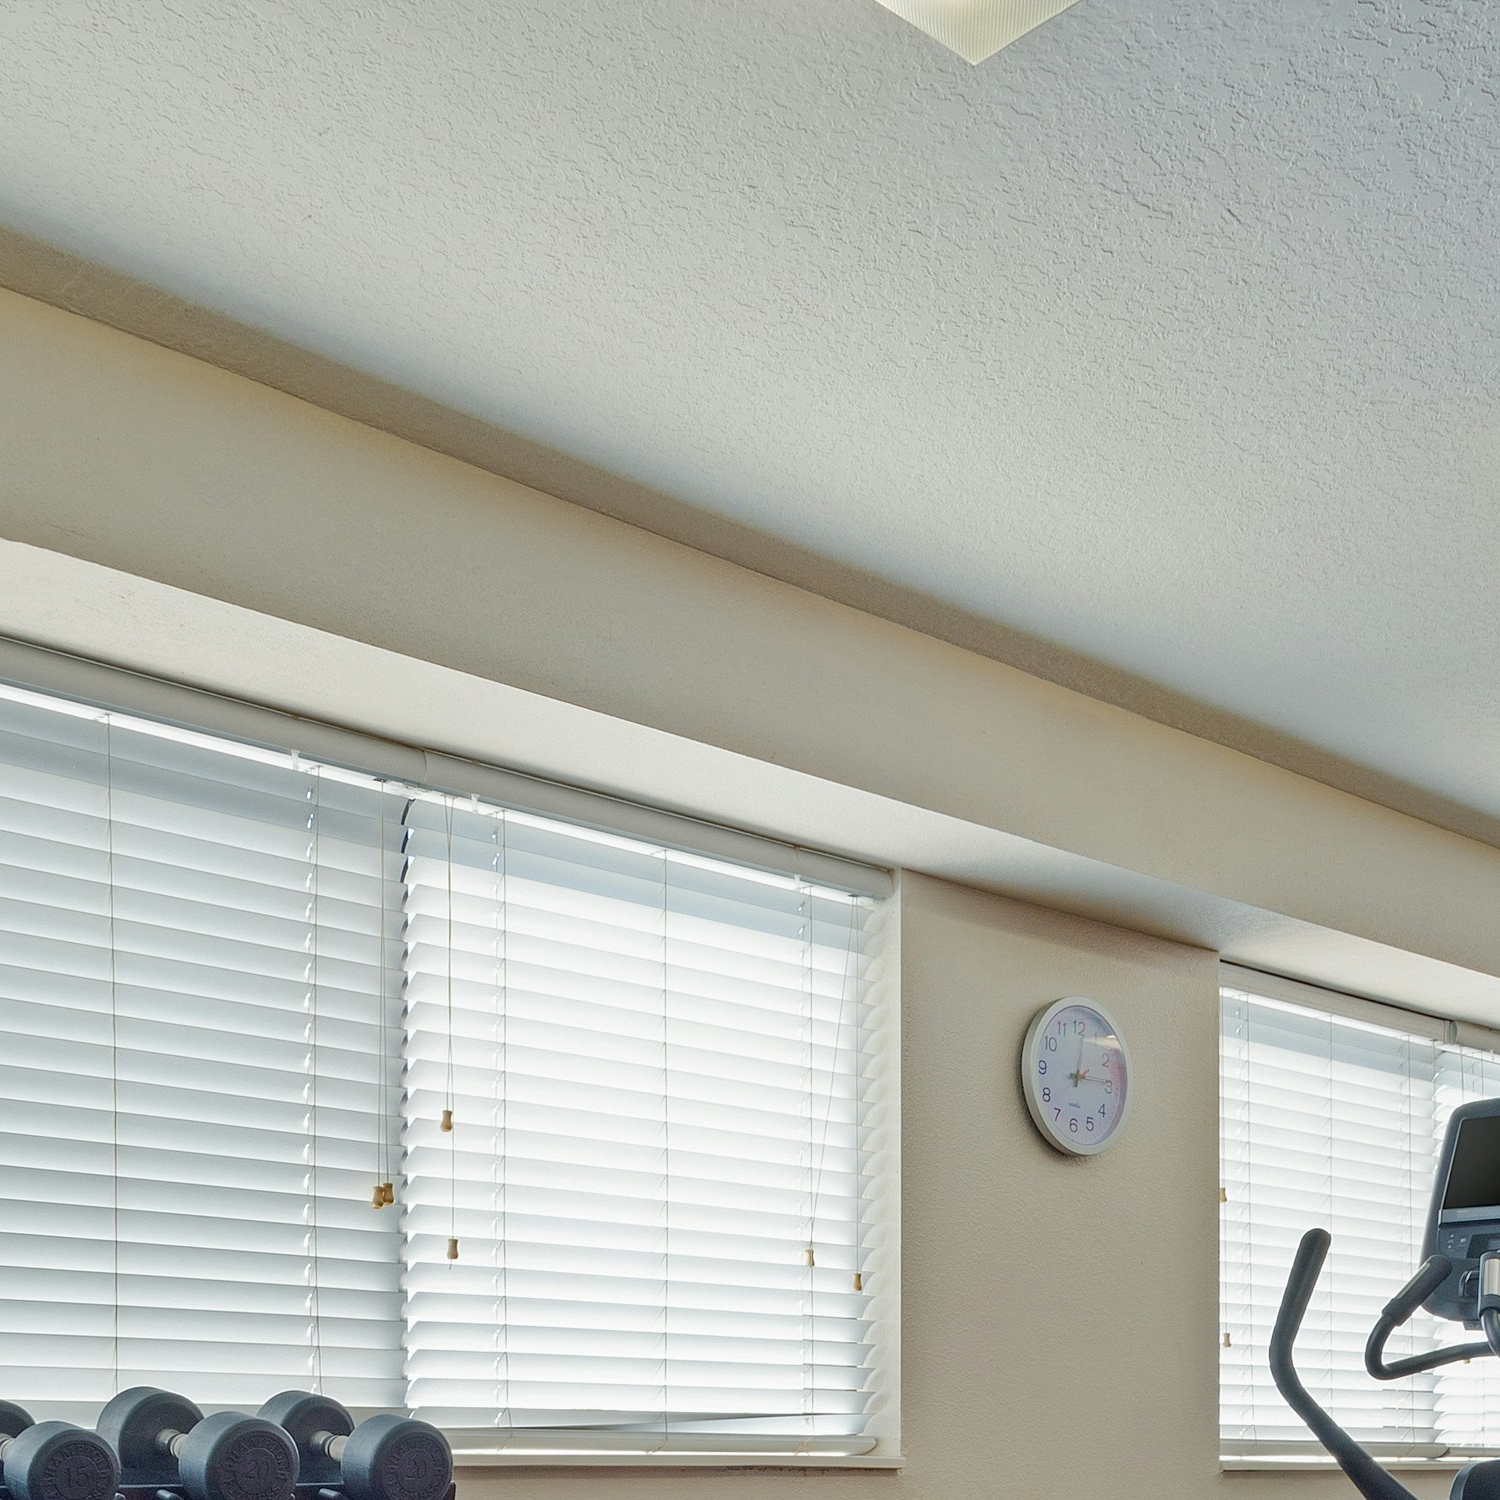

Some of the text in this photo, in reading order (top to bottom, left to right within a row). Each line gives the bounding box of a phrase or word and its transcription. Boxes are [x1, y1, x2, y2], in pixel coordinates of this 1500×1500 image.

[1058, 1021, 1066, 1037] 11
[1073, 1020, 1086, 1037] 12
[1045, 1035, 1057, 1052] 10
[1038, 1060, 1047, 1075] 9
[1101, 1053, 1110, 1068] 2
[1042, 1087, 1051, 1102] 8
[1105, 1080, 1113, 1094] 3
[1053, 1107, 1061, 1122] 7
[1098, 1104, 1106, 1118] 4
[1069, 1118, 1078, 1133] 6
[1086, 1116, 1094, 1132] 5
[243, 1458, 270, 1480] 20
[405, 1459, 428, 1481] 20
[66, 1466, 90, 1489] 15
